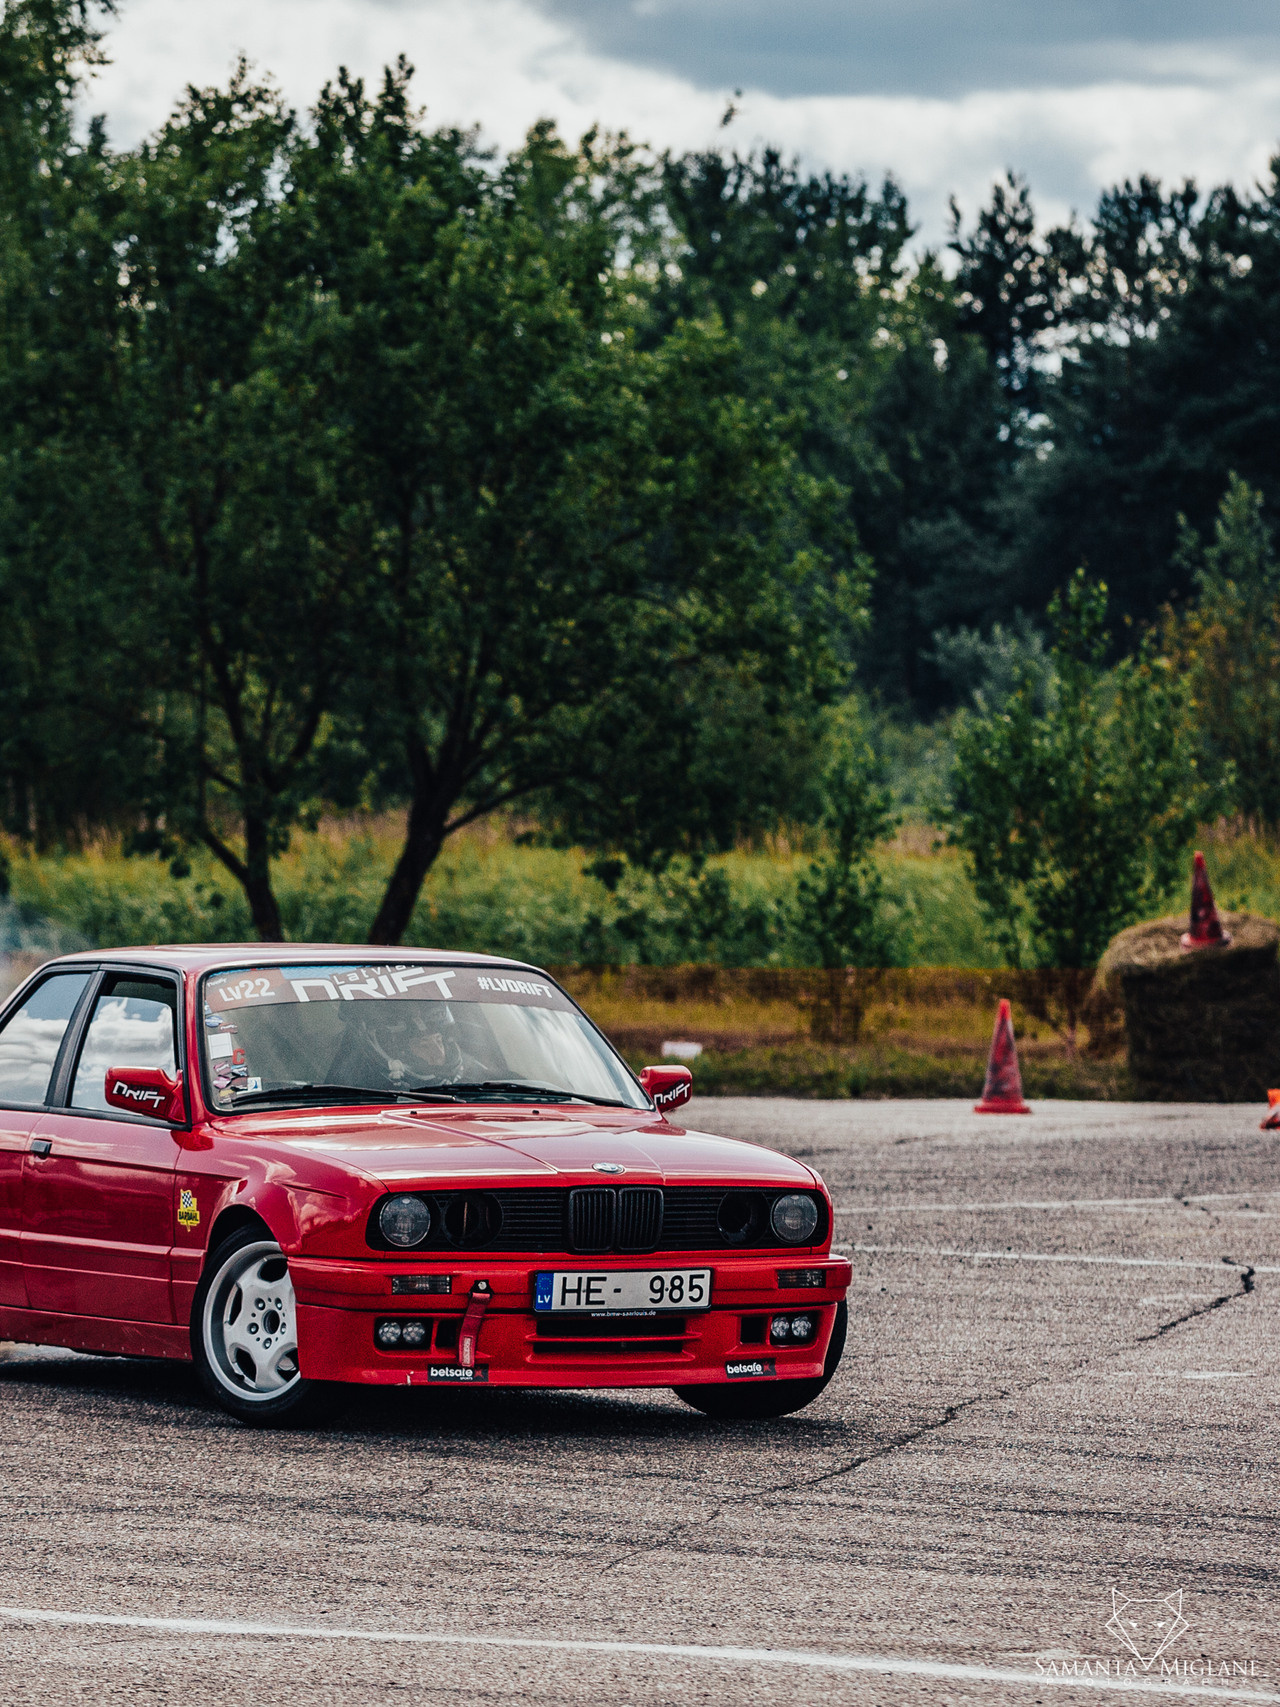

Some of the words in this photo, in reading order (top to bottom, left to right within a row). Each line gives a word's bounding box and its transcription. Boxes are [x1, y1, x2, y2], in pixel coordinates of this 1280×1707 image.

[219, 978, 276, 1002] LV22
[290, 966, 457, 1002] DRIFT
[477, 976, 553, 998] #LVDRIFT
[112, 1081, 166, 1108] DRIFT
[653, 1083, 691, 1103] DRIFT
[537, 1294, 551, 1303] LV
[727, 1362, 762, 1374] betsafe
